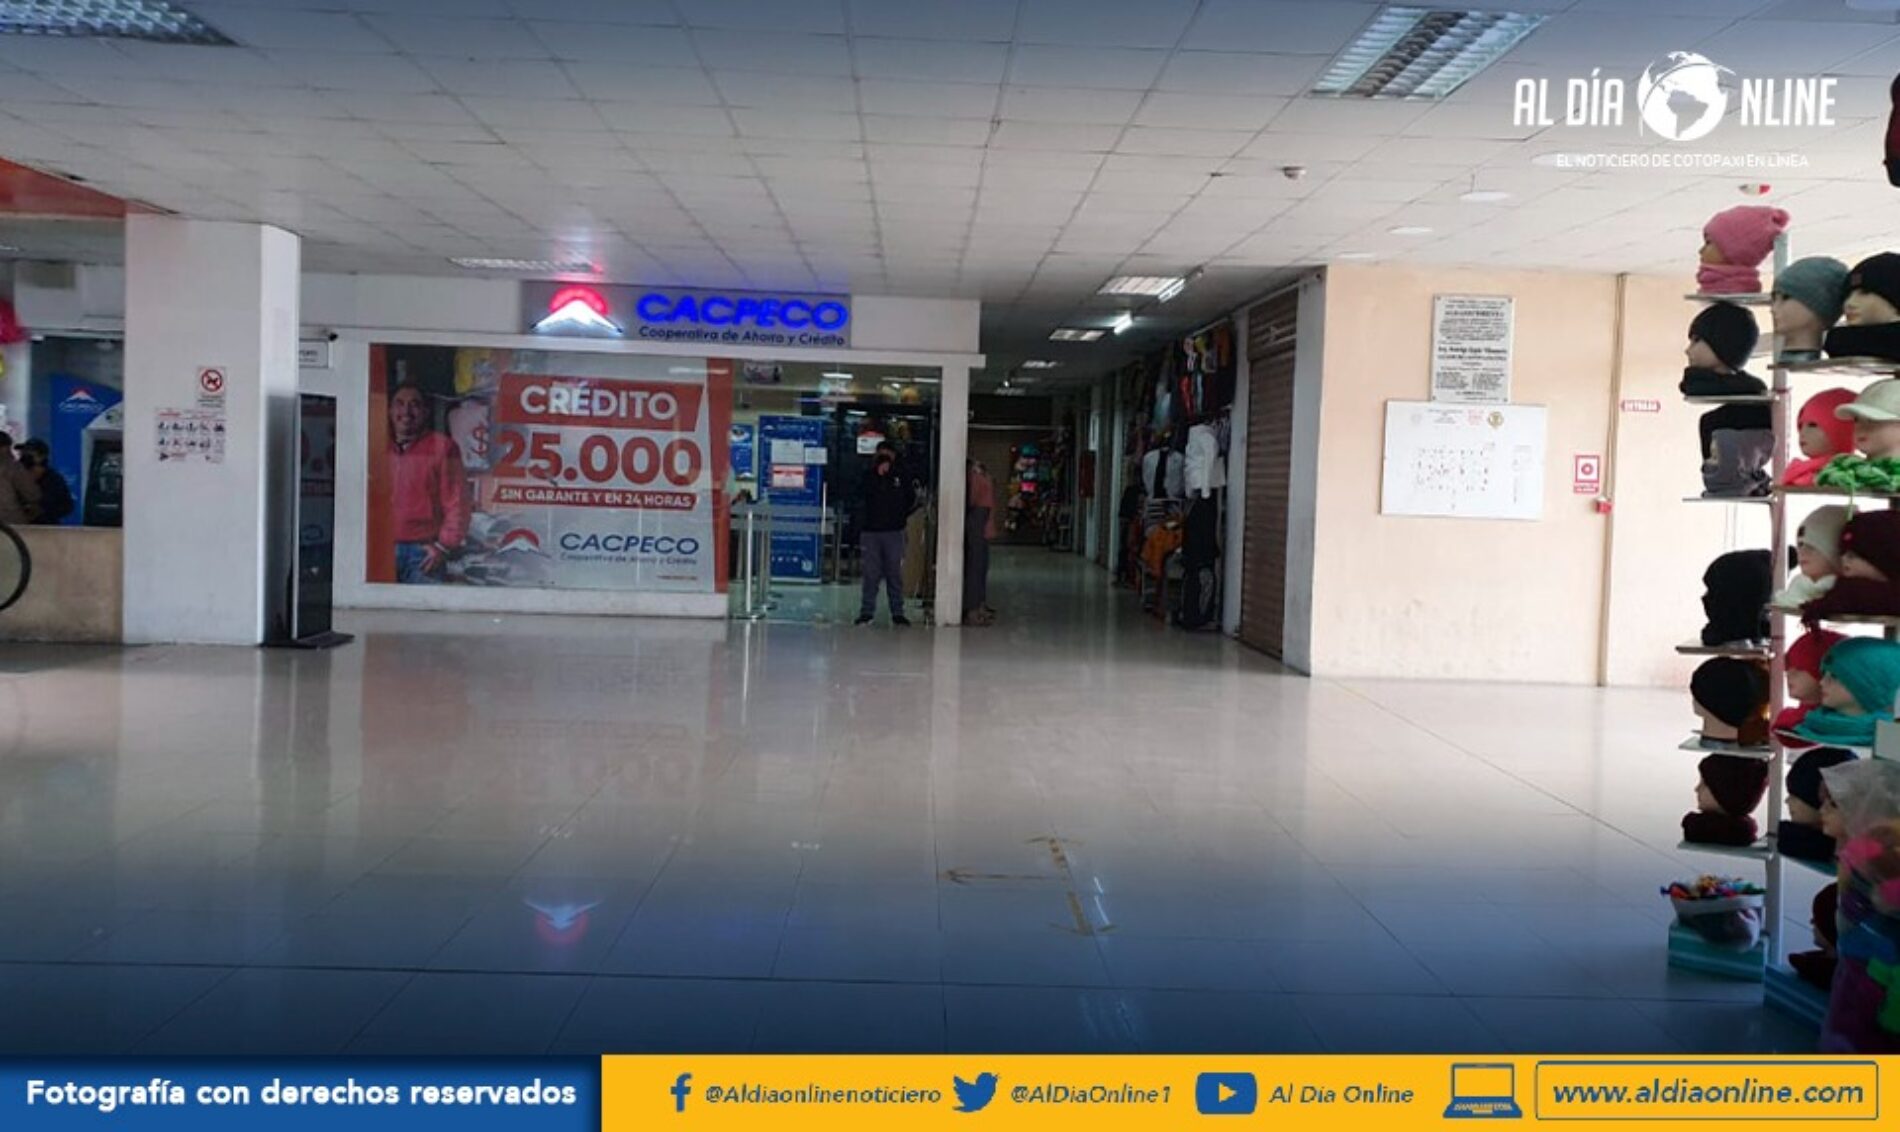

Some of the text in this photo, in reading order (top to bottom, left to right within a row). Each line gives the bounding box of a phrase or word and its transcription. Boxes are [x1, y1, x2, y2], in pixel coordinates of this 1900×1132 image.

[636, 293, 849, 331] CACPECO
[639, 325, 845, 347] Cooperativa de Ahorro y Crédito
[519, 381, 678, 420] CRÉDITO
[492, 430, 702, 487] 25.000
[501, 488, 692, 508] SIN GARANTE Y EN 24 HORAS
[560, 532, 699, 555] CACPECO
